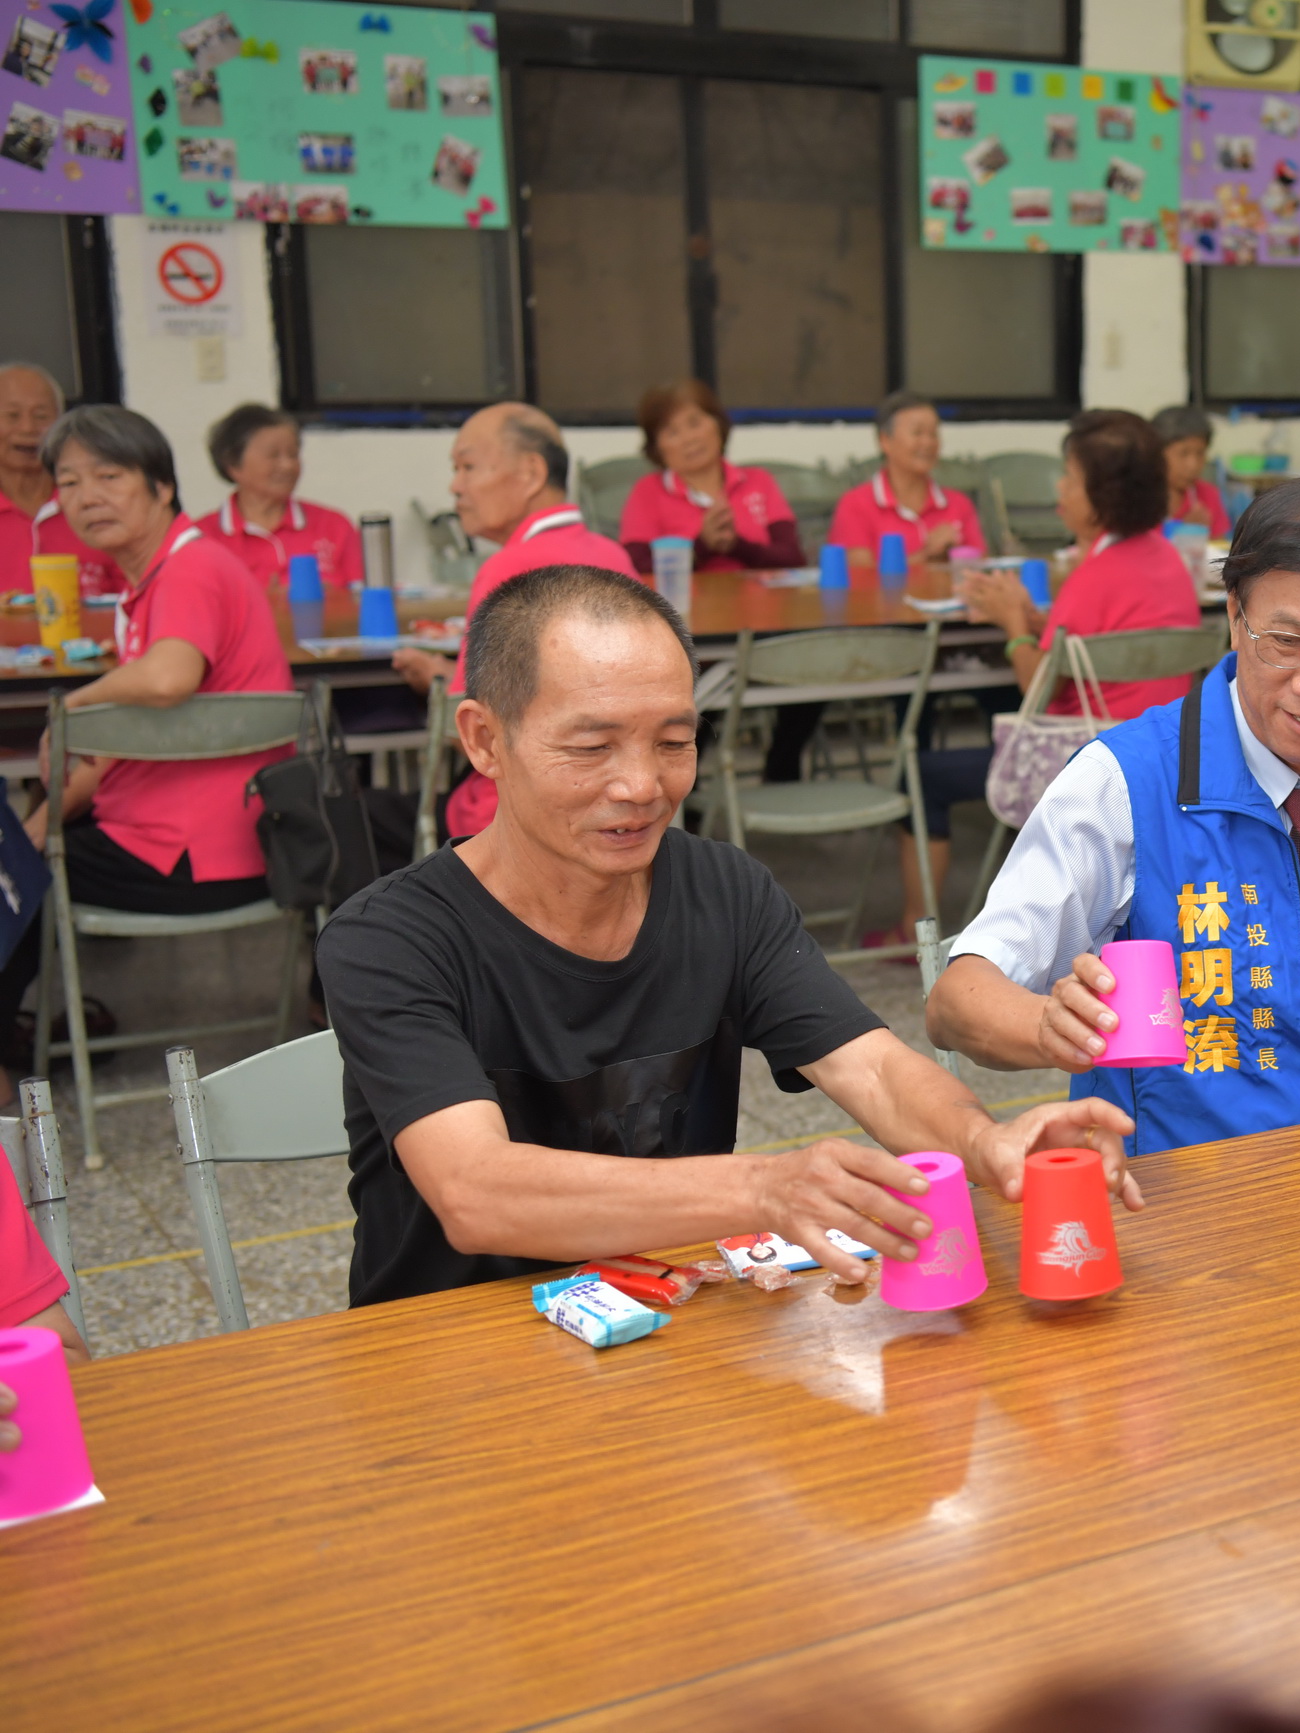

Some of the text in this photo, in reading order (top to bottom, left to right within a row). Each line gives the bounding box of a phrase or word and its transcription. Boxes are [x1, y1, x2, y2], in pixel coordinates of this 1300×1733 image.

[1176, 881, 1240, 1074] 林明溱
[1240, 883, 1279, 1070] 南投縣縣長
